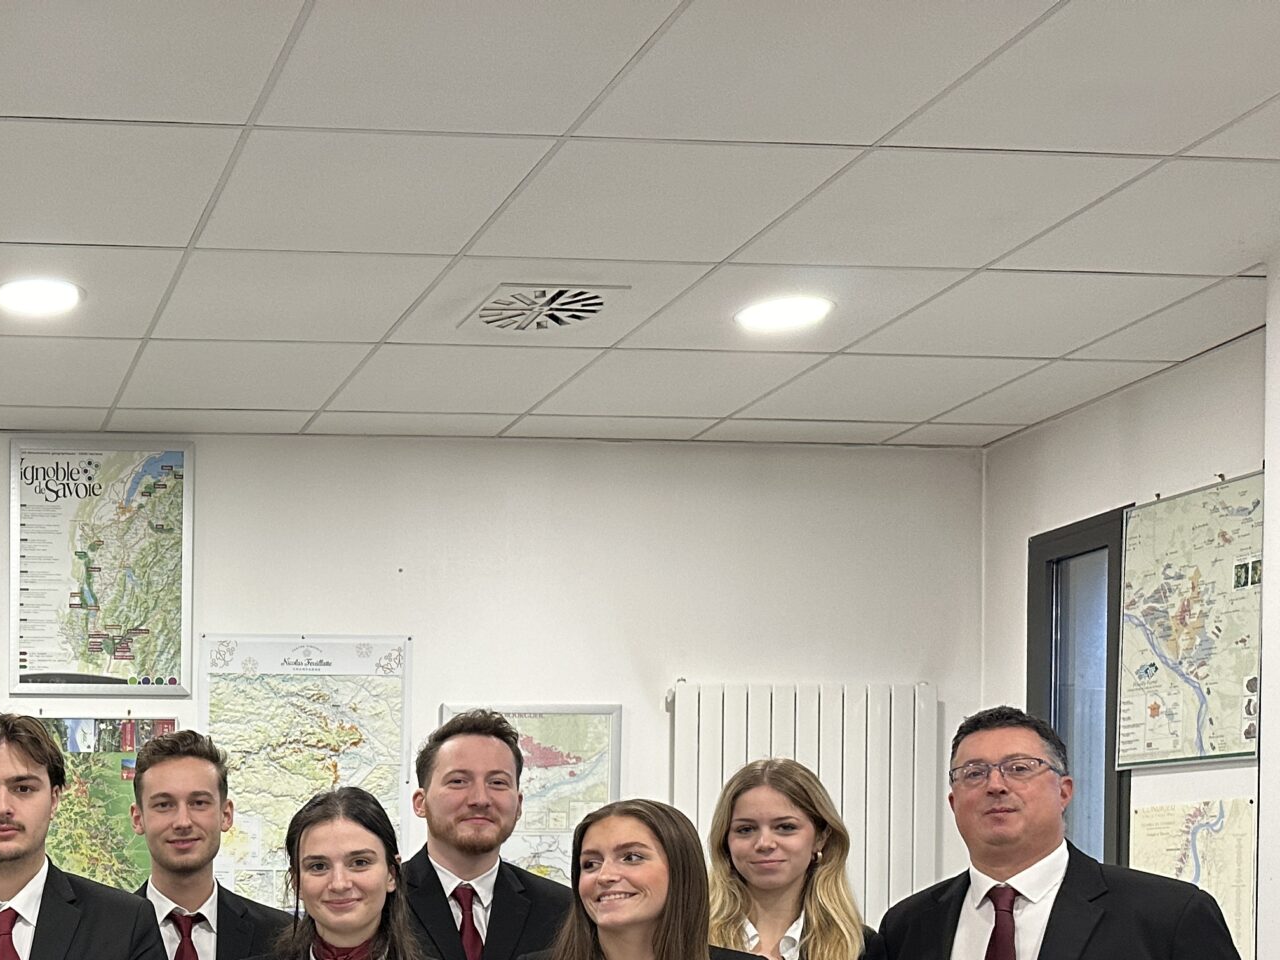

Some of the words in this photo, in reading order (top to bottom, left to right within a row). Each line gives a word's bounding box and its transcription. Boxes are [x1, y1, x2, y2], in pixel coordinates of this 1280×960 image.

[34, 481, 46, 495] de
[45, 479, 102, 503] Savoie
[280, 657, 303, 667] Nicolas
[304, 658, 332, 667] Feuillatte
